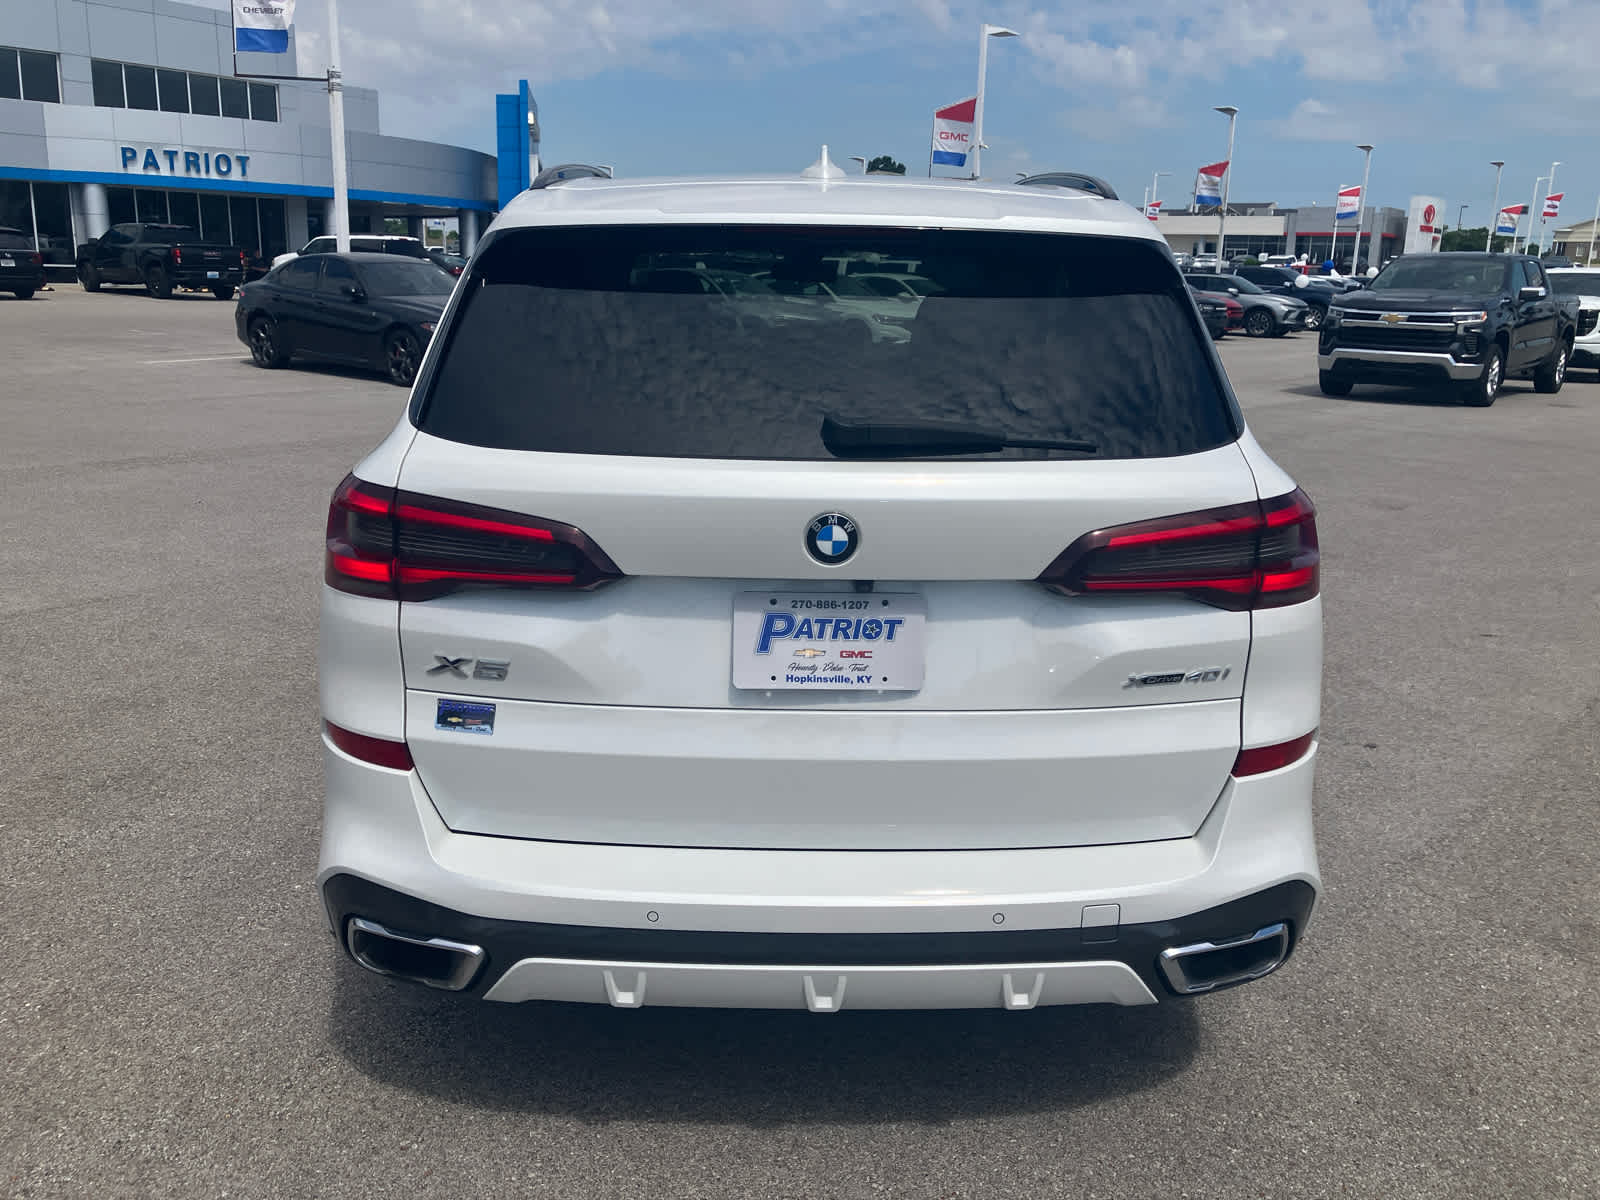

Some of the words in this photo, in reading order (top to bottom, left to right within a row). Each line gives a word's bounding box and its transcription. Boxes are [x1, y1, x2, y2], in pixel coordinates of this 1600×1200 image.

[940, 131, 968, 142] GMC
[120, 145, 251, 177] PATRIOT
[811, 515, 857, 533] BMW
[791, 600, 869, 610] 270-886-1207
[755, 611, 904, 655] PATRIOT
[840, 650, 873, 659] GMC
[426, 655, 511, 681] X5
[785, 674, 854, 685] Hopkinsville,
[856, 675, 872, 684] KY
